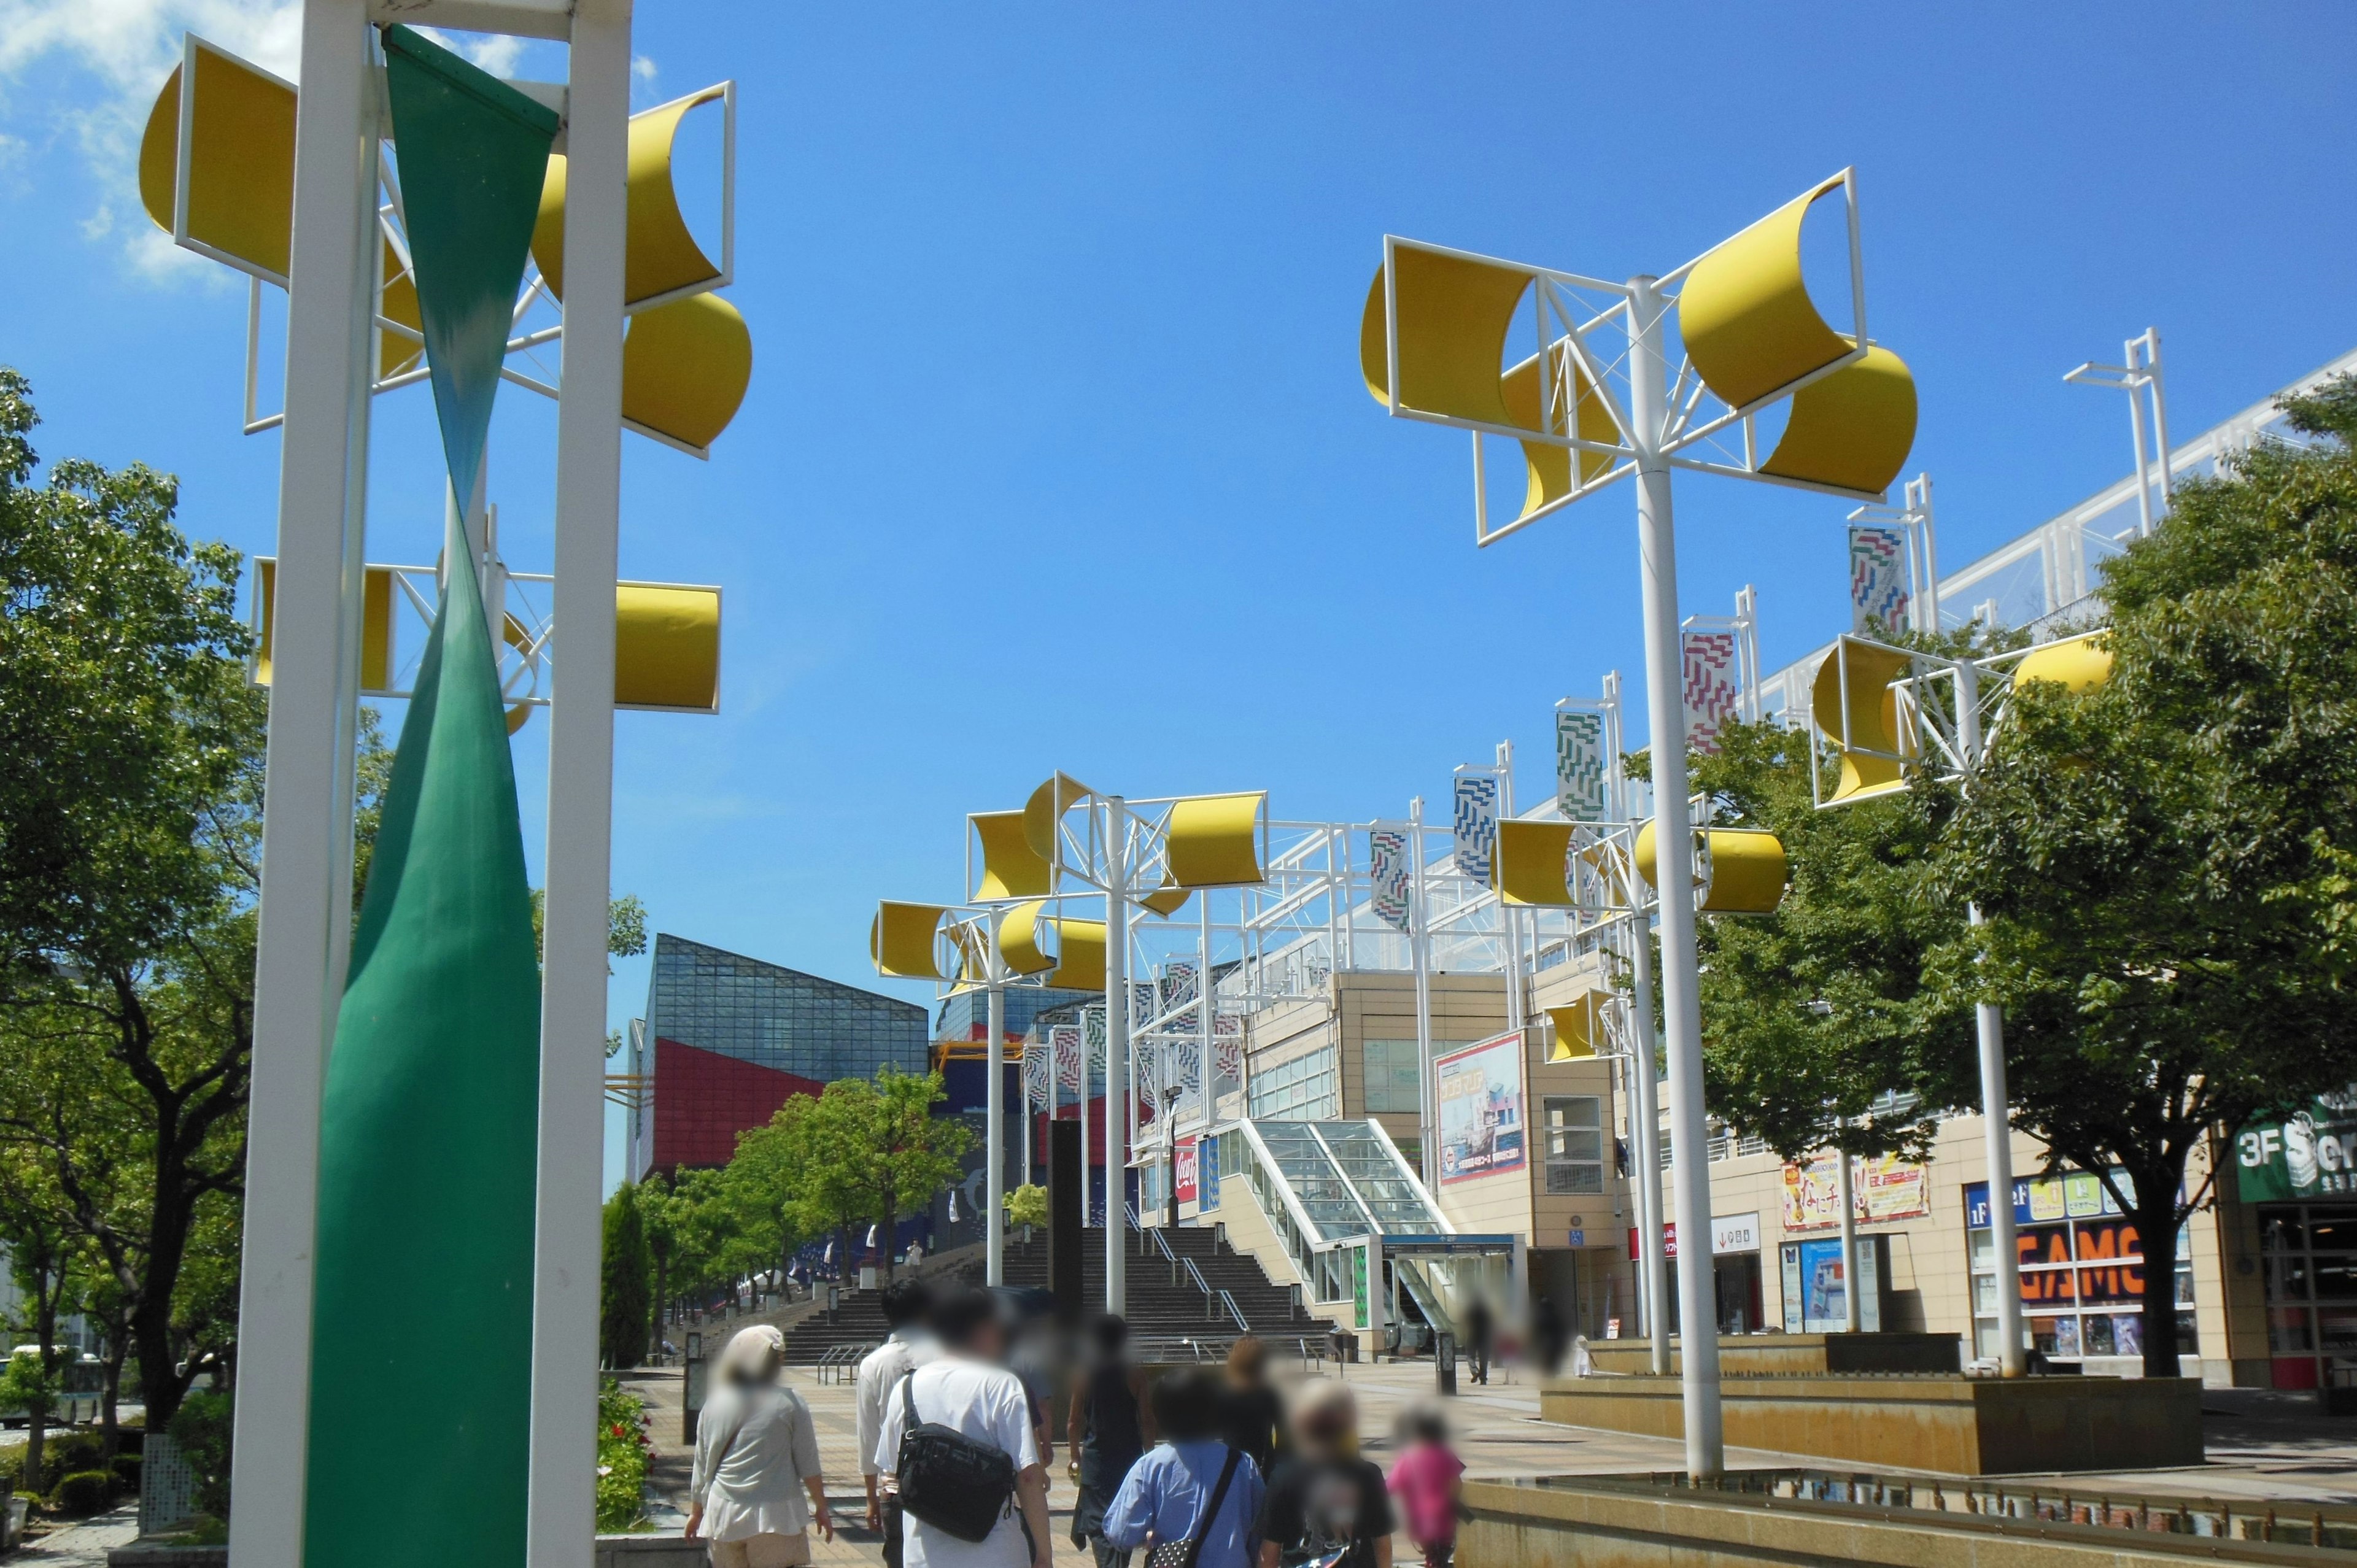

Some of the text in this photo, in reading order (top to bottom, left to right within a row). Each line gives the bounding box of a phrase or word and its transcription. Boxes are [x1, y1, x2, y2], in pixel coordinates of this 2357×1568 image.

[2239, 1129, 2280, 1167] 3F
[1972, 1202, 1987, 1225] 1F
[2016, 1225, 2145, 1300] GAME
